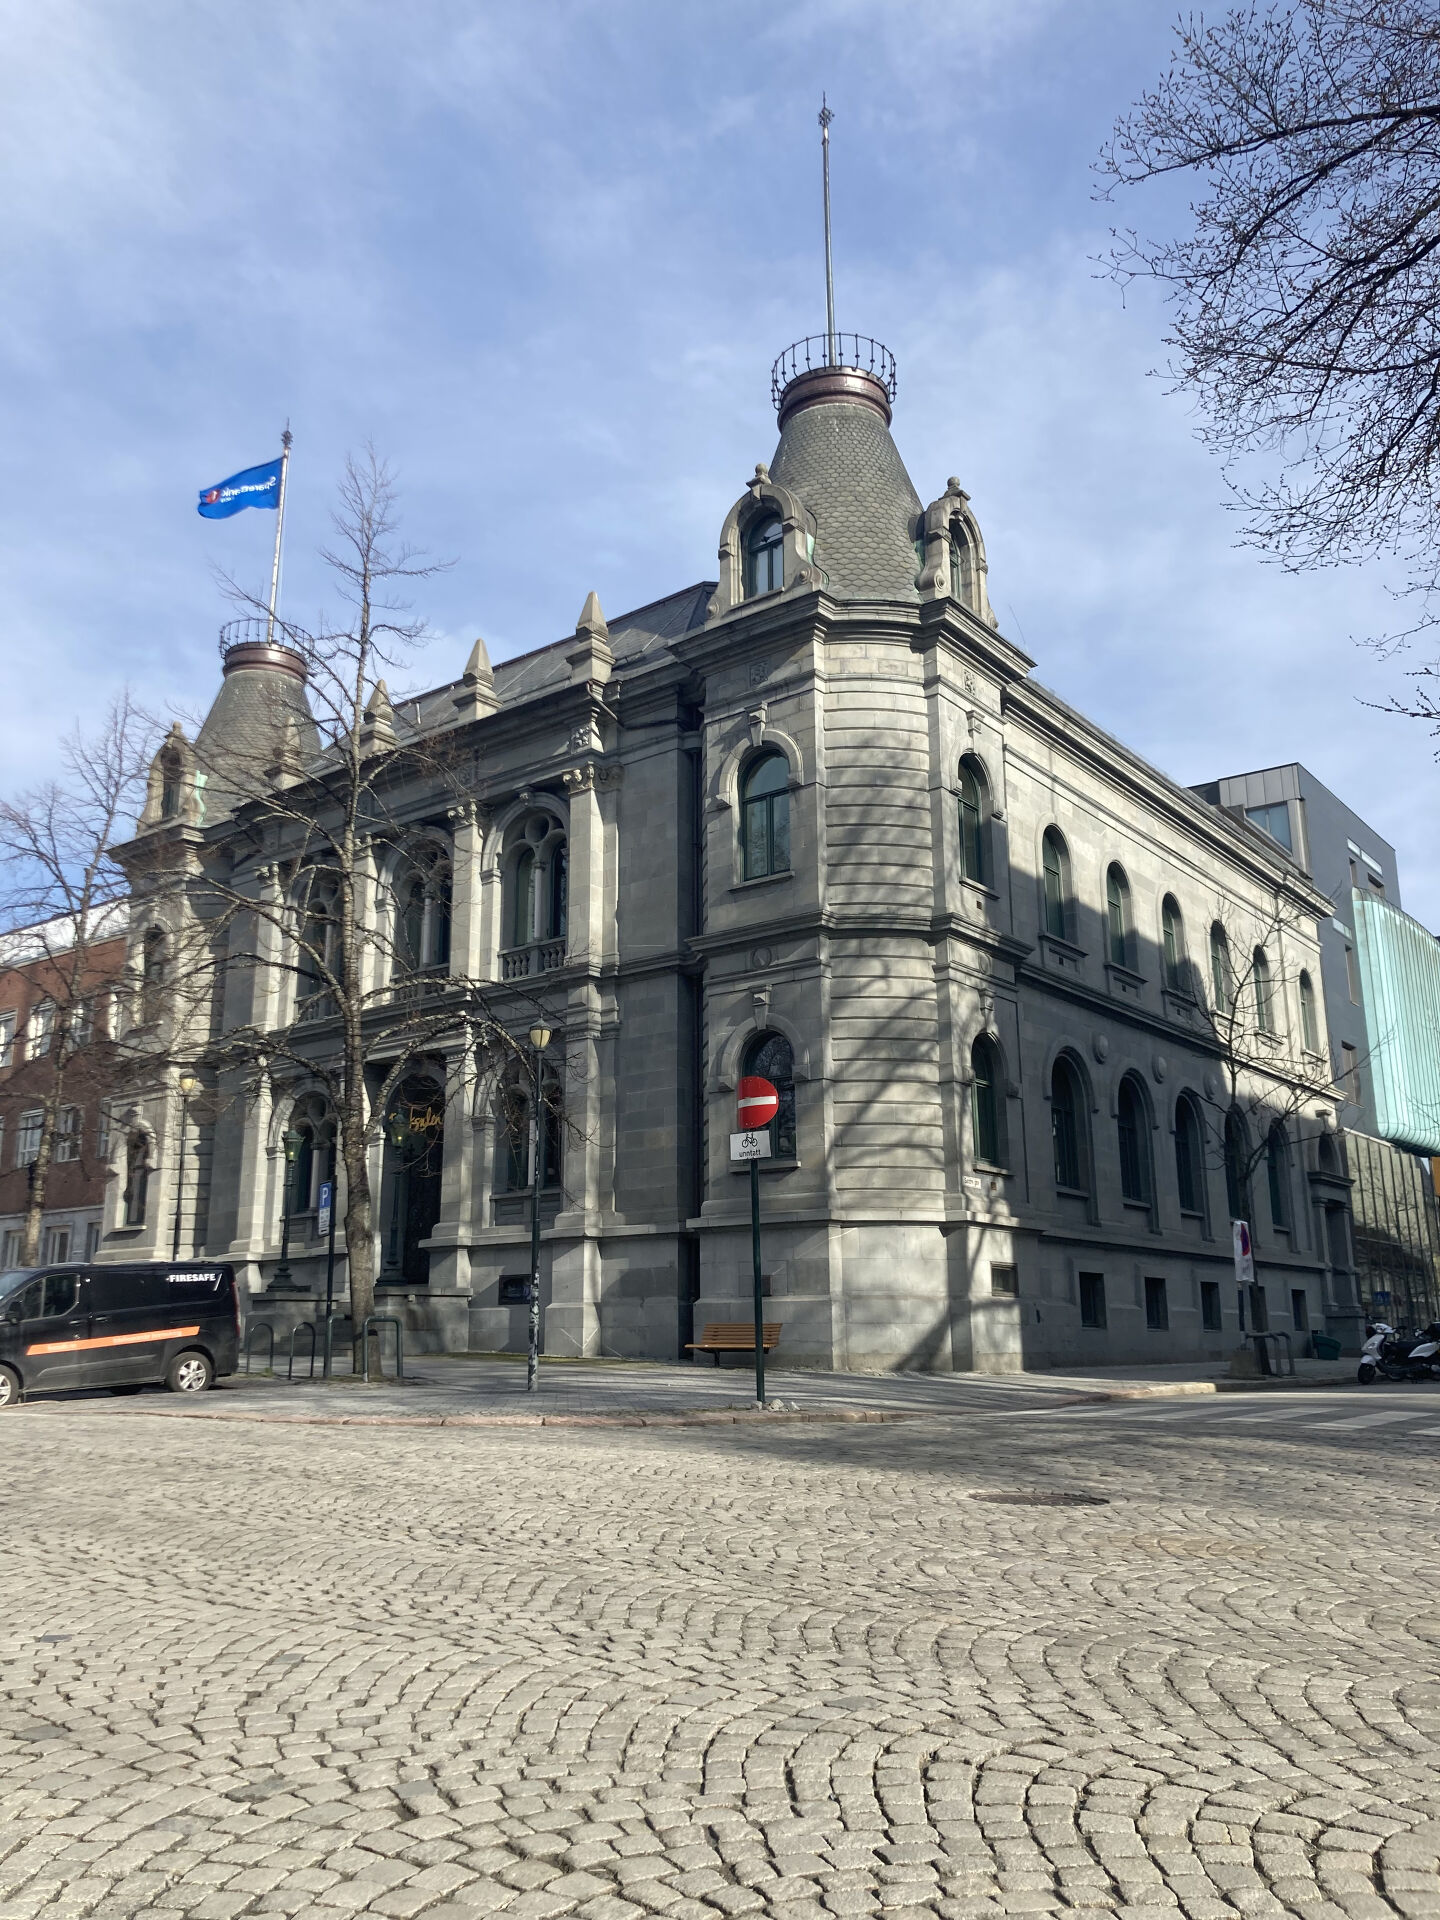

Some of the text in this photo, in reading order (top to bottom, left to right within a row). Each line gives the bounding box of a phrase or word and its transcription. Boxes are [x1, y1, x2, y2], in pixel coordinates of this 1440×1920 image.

[738, 1149, 761, 1158] unntatt
[322, 1187, 329, 1206] P
[169, 1273, 216, 1283] FIRESAFE
